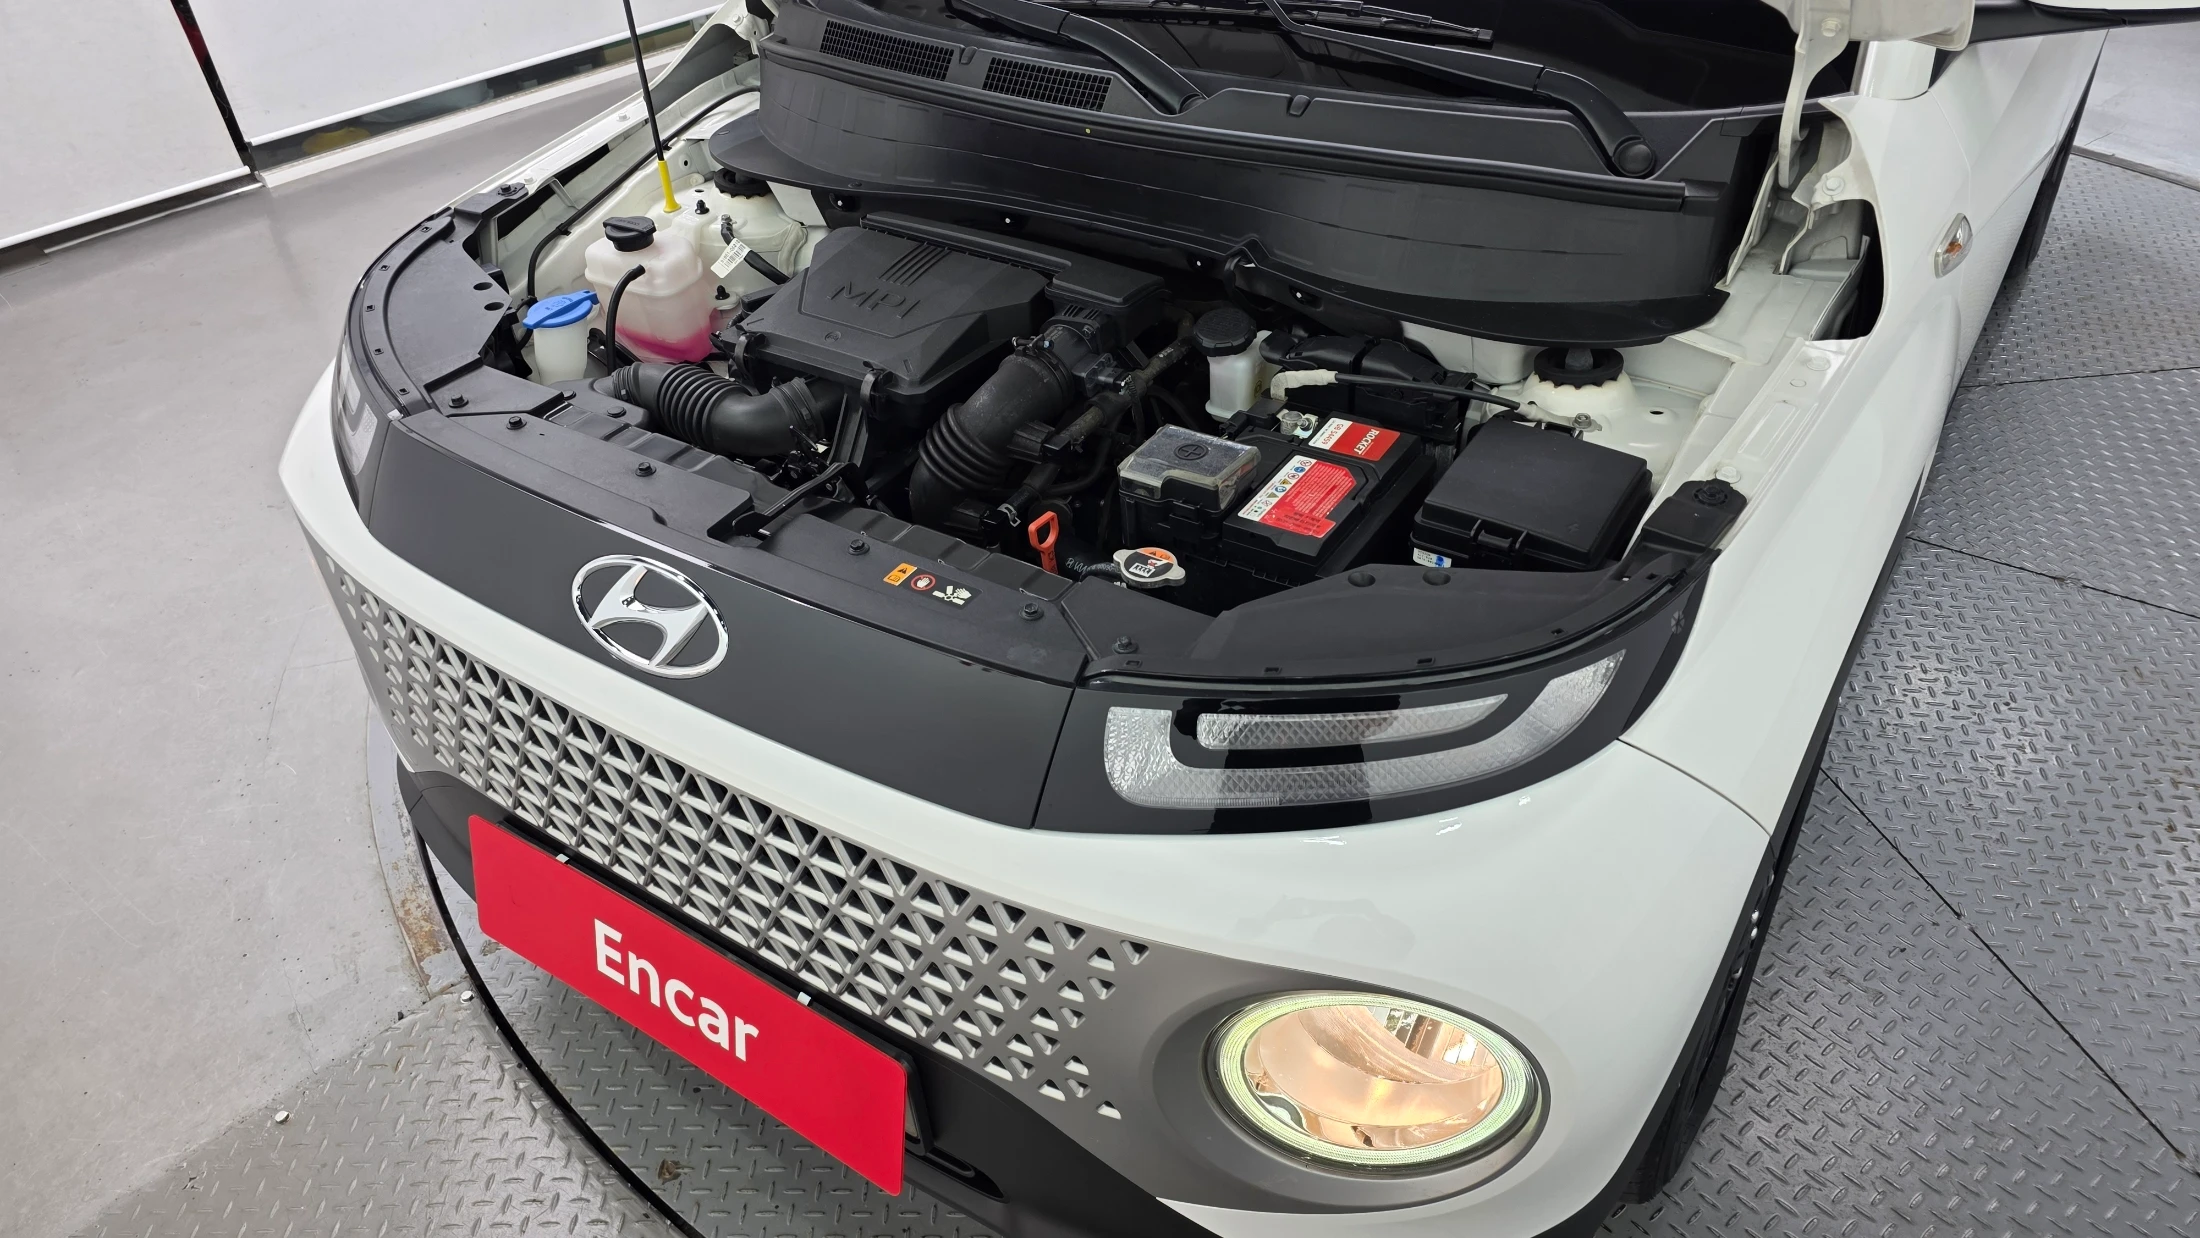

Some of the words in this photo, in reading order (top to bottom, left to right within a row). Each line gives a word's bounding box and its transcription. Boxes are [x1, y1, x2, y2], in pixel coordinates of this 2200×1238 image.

[826, 280, 921, 319] MPI
[1353, 428, 1380, 455] ROCKET
[594, 918, 760, 1062] Encar
